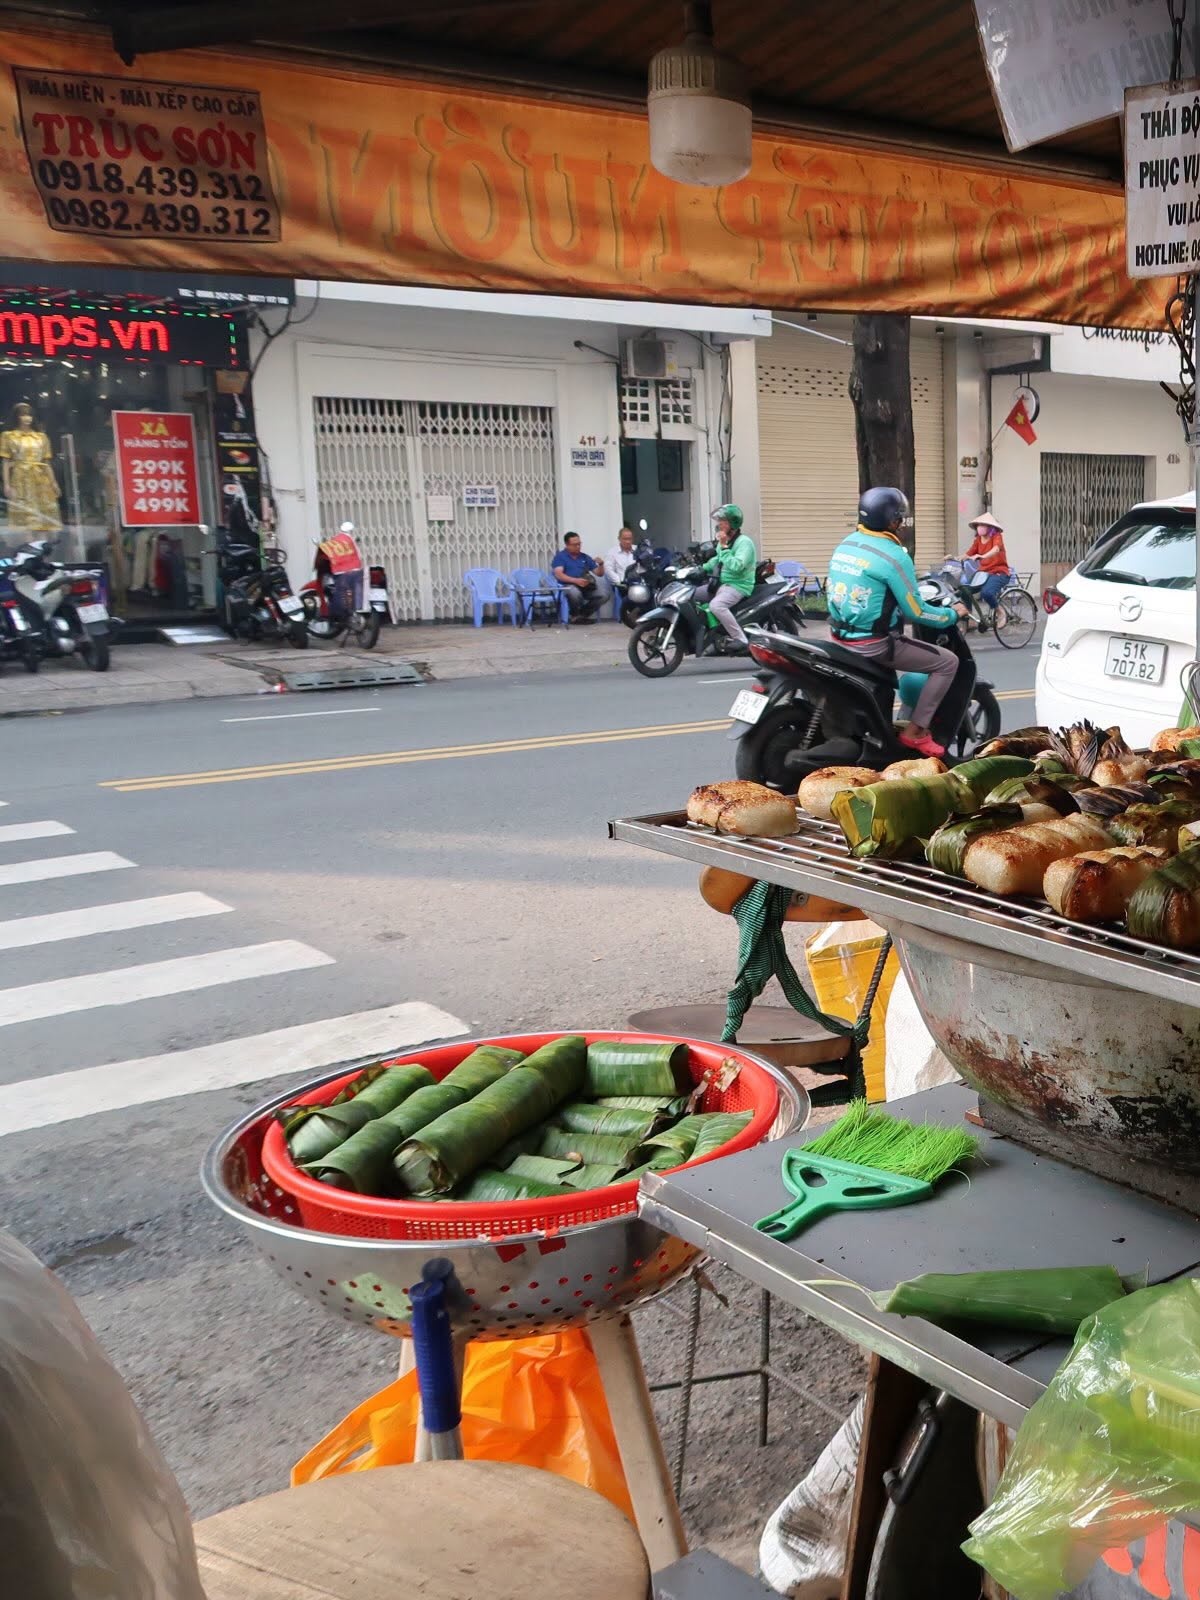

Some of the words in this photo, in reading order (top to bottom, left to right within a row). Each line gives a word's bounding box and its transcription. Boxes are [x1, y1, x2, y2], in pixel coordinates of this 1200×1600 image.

[63, 80, 105, 103] HIÊN
[156, 87, 187, 109] XẾP
[192, 96, 222, 114] CAO
[1141, 101, 1177, 140] THÁI
[1181, 96, 1200, 138] ĐỘ
[32, 108, 163, 163] TRÚC
[172, 122, 257, 171] SƠN
[38, 160, 267, 202] 0918.439.312
[1139, 157, 1180, 192] PHỤC
[1183, 153, 1200, 188] VỤ
[51, 198, 271, 235] 0982.439.312
[1167, 203, 1187, 226] VUI
[1135, 241, 1189, 267] HOTLINE:
[579, 435, 596, 446] 411
[130, 460, 186, 475] 299K
[132, 479, 188, 494] 399K
[133, 498, 190, 512] 499K
[1123, 642, 1148, 660] 51K
[1112, 659, 1156, 680] 707.82
